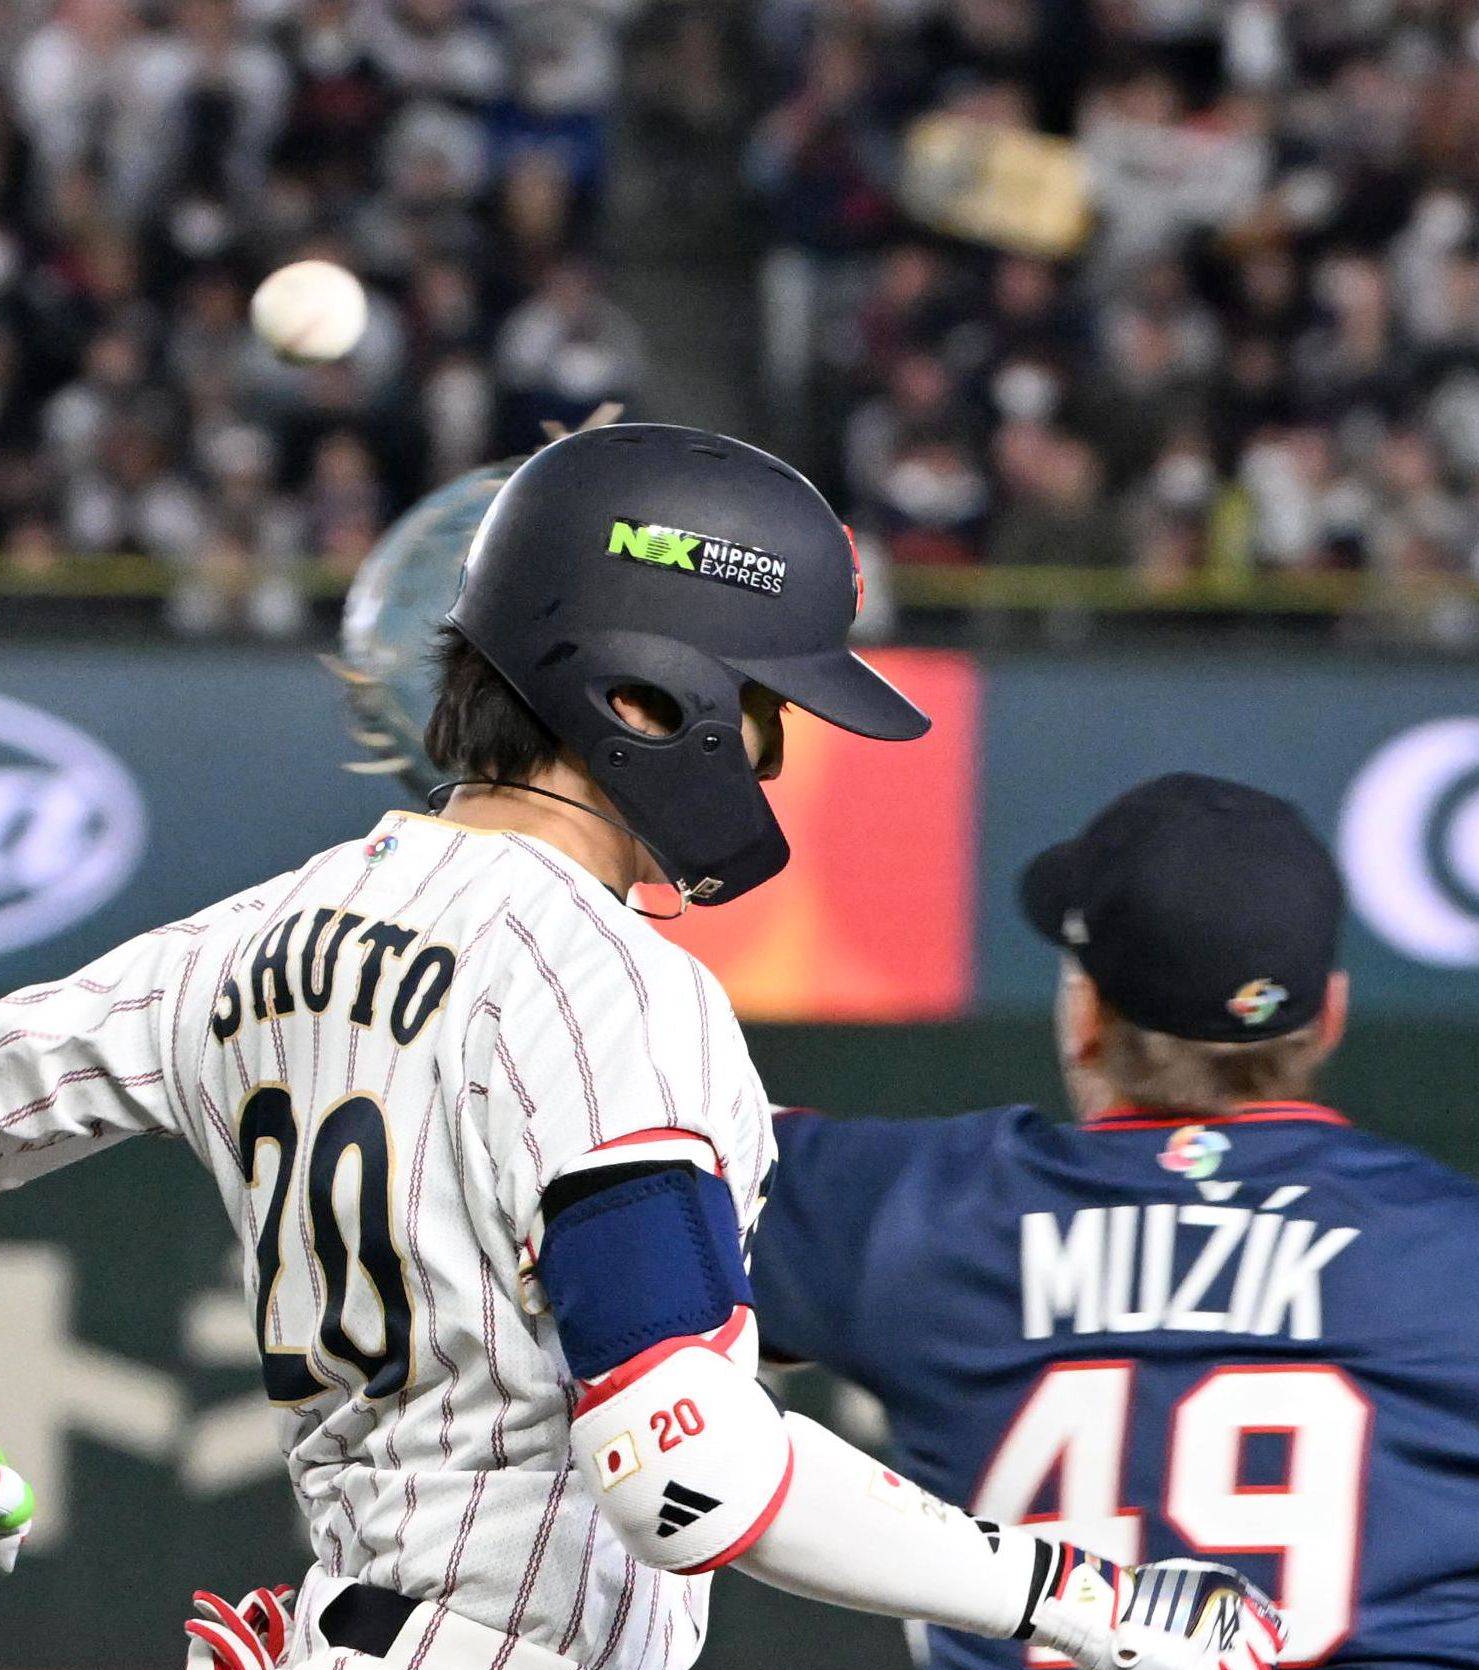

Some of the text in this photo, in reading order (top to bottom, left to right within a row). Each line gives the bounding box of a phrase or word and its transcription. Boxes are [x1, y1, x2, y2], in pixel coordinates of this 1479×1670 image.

[699, 559, 782, 593] EXPRESS
[703, 542, 786, 577] NIPPON
[237, 1080, 418, 1408] 20
[1020, 1180, 1361, 1340] MUŽÍK
[650, 1398, 706, 1453] 20
[972, 1359, 1376, 1670] 49
